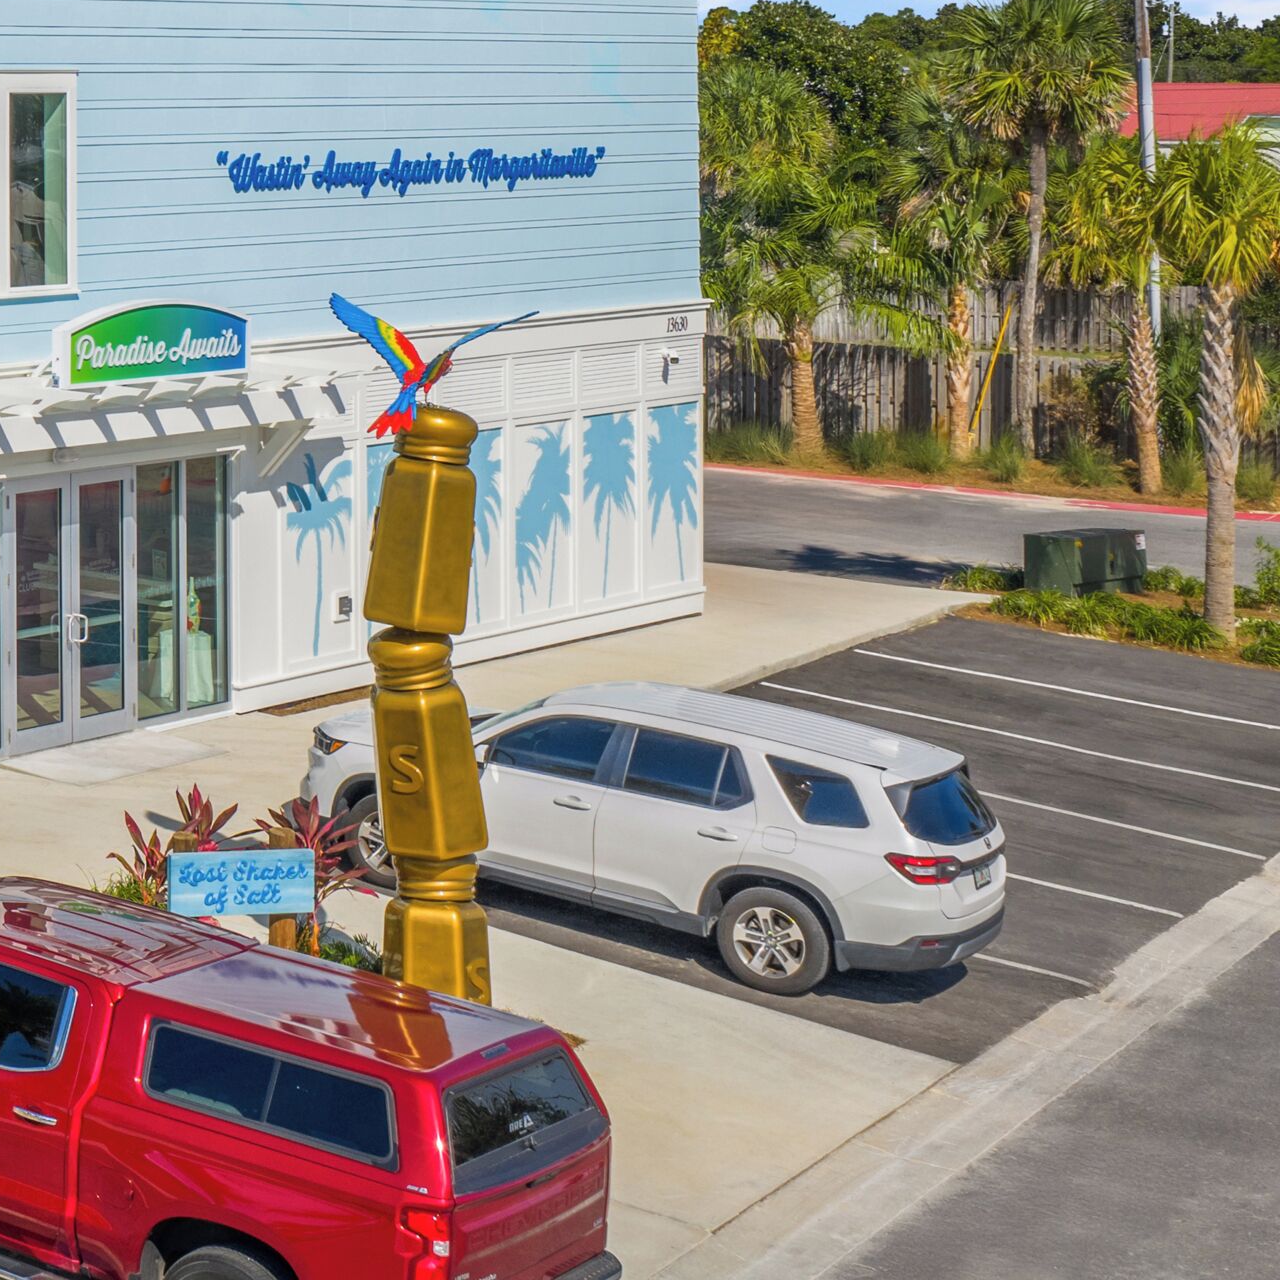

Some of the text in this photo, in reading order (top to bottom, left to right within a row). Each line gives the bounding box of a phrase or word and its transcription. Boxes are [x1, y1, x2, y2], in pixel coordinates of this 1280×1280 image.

[312, 150, 378, 198] Away
[379, 148, 443, 197] Again
[445, 151, 466, 183] in
[666, 315, 688, 333] 13630
[76, 327, 242, 371] Paradise Awaits
[178, 858, 309, 887] Lost Shaker
[204, 882, 282, 913] of Salt
